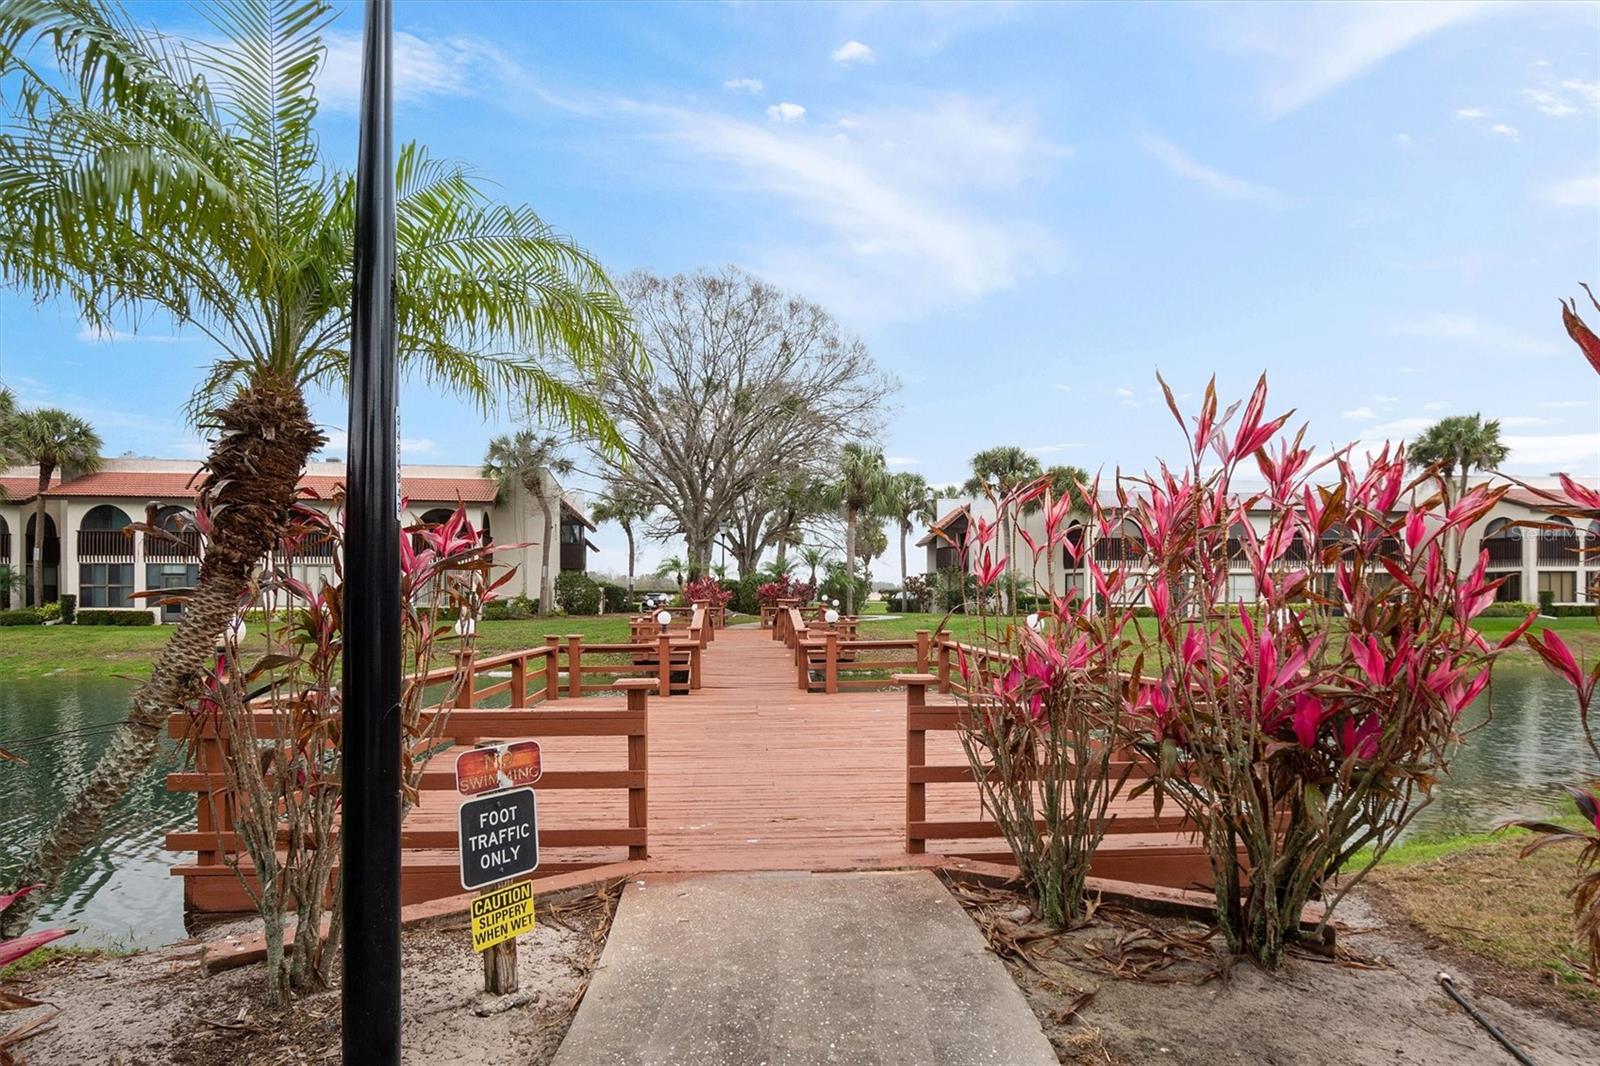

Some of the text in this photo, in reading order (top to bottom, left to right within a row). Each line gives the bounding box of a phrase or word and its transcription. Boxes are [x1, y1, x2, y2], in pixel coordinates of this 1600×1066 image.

[483, 751, 512, 771] NO
[480, 805, 518, 828] FOOT
[469, 823, 530, 851] TRAFFIC
[480, 845, 520, 869] ONLY
[474, 884, 530, 916] CAUTION
[475, 913, 533, 945] WHEN WET
[479, 902, 527, 929] SLIPPERY
